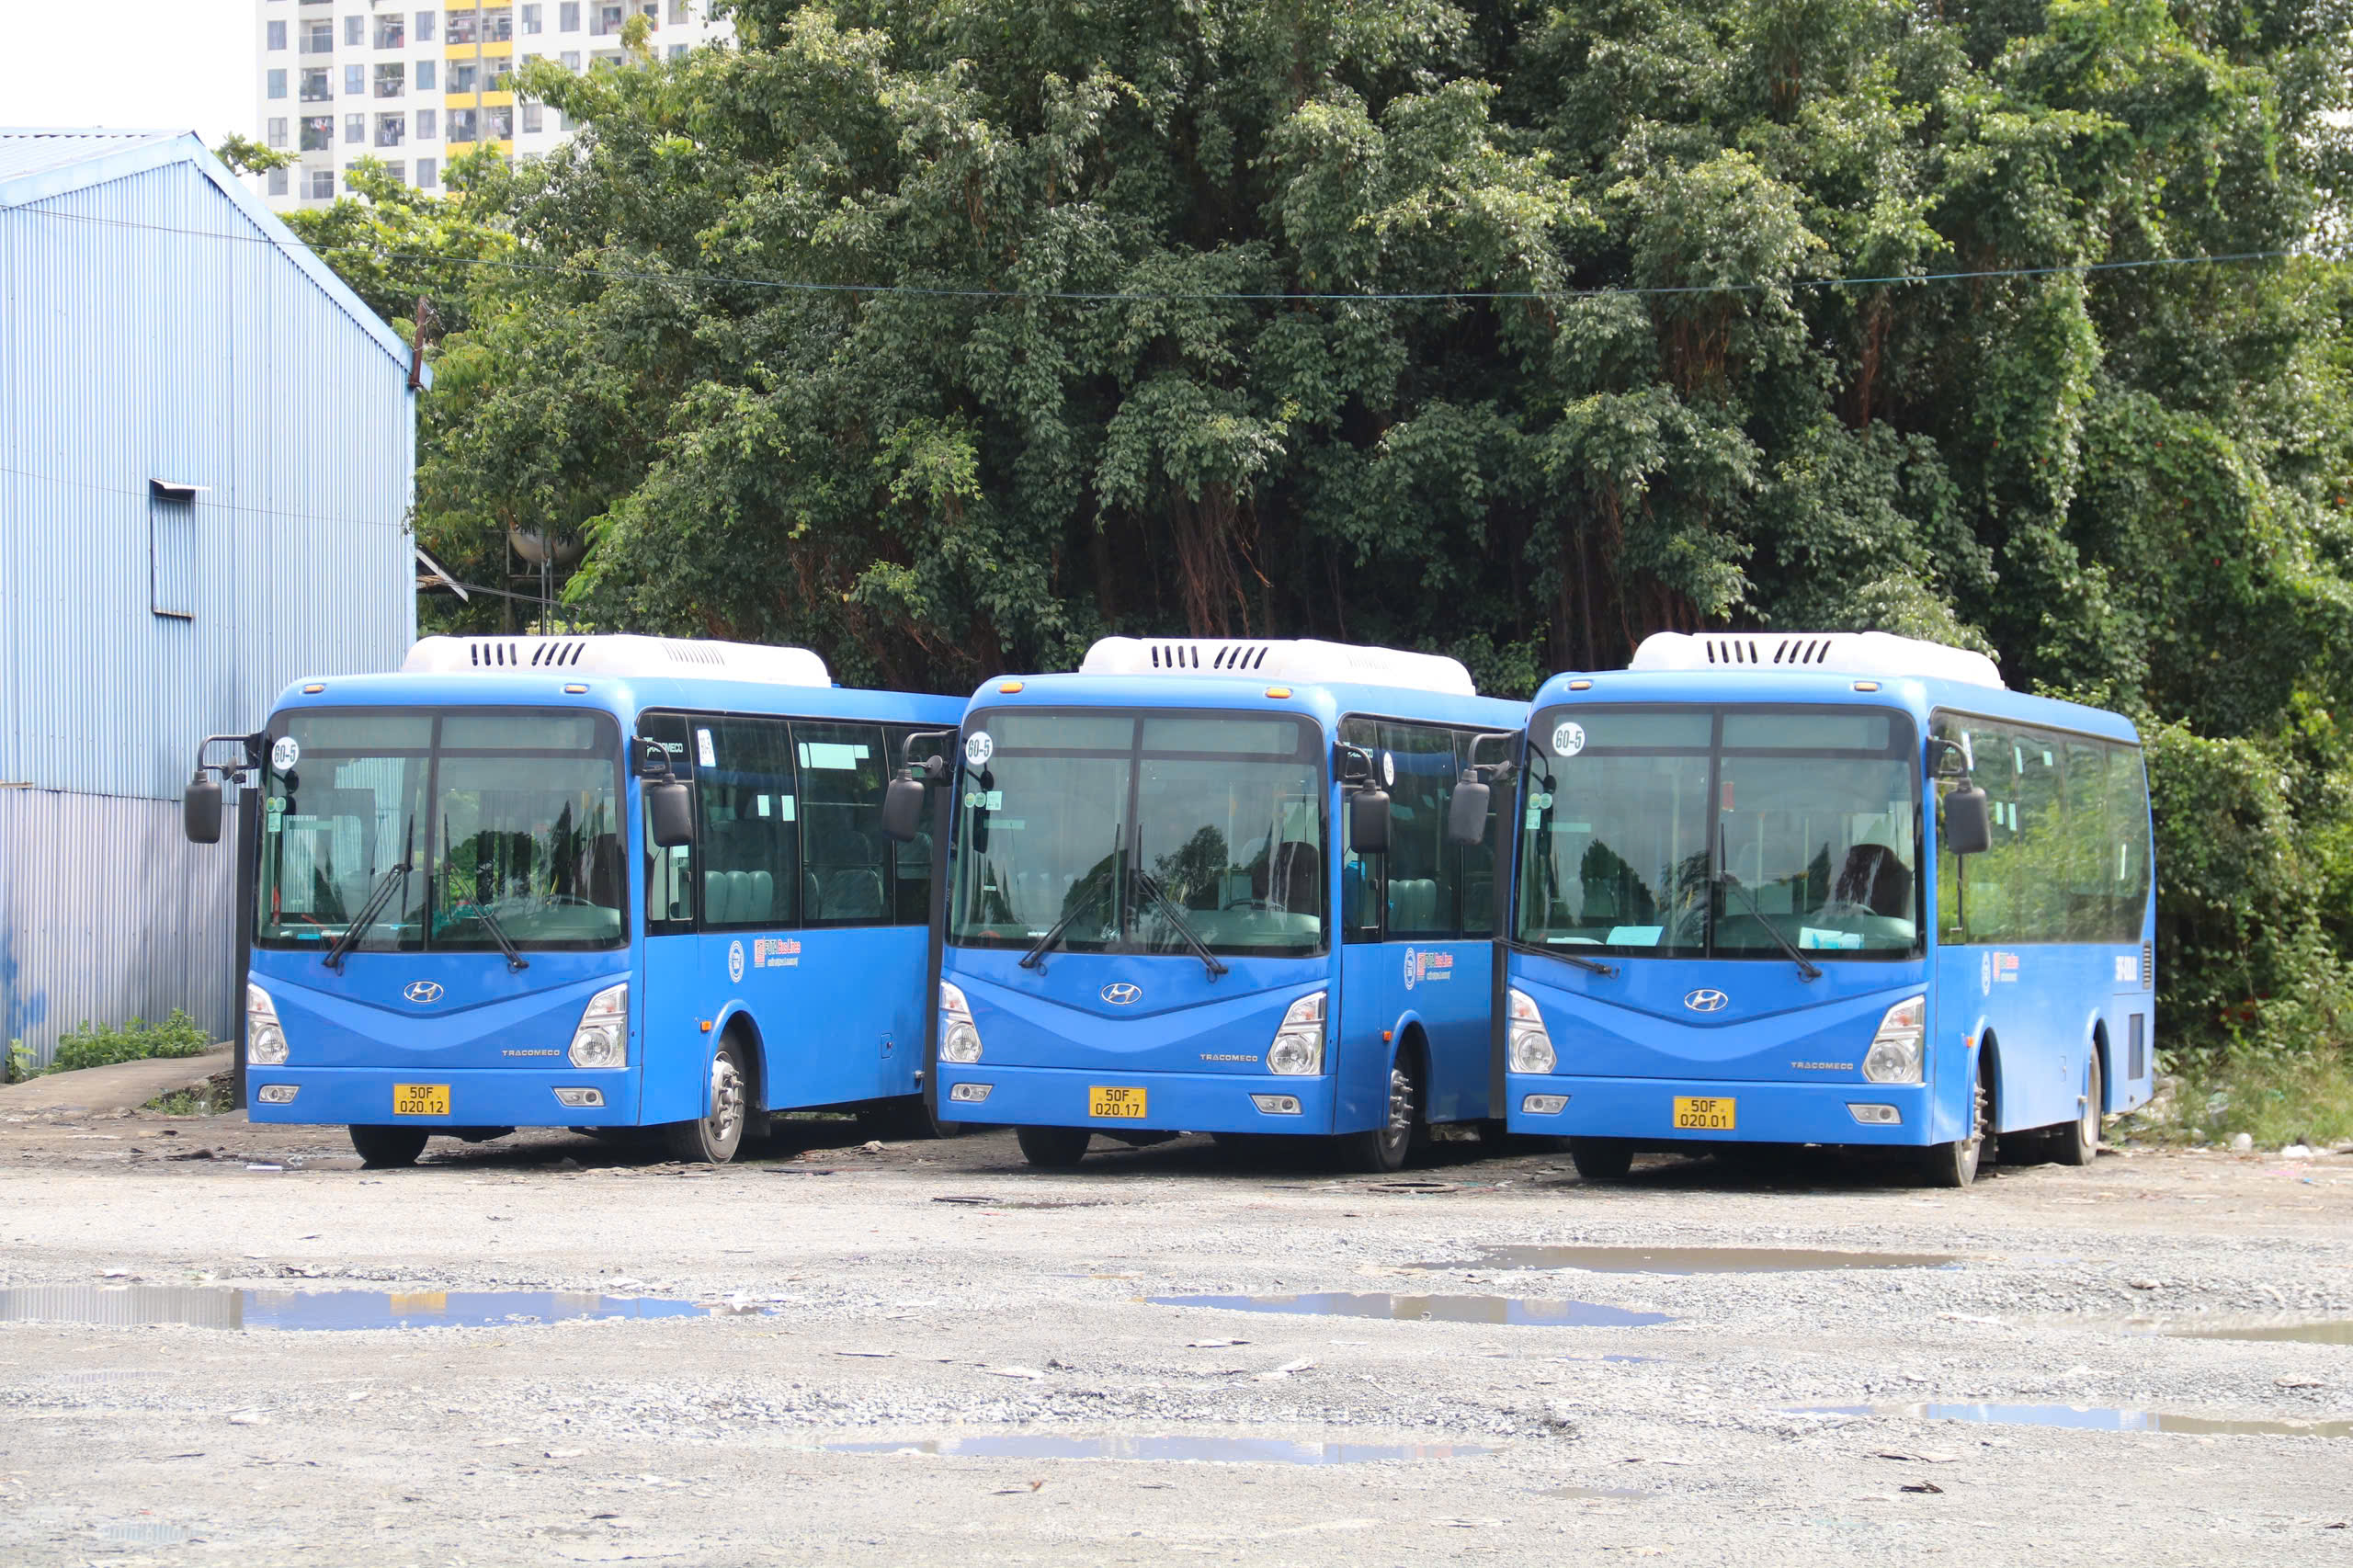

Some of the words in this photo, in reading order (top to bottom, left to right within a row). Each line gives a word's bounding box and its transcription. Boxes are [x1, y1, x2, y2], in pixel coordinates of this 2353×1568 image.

[1555, 730, 1582, 749] 60-5
[274, 744, 296, 763] 60-5
[968, 739, 990, 757] 60-5
[501, 1050, 560, 1058] TRACOMECO
[1199, 1053, 1258, 1062] TRACOMECO
[1790, 1061, 1854, 1071] TRACOMECO
[410, 1086, 434, 1099] 50F
[1106, 1089, 1130, 1102] 50F
[400, 1100, 443, 1113] 020.12
[1096, 1103, 1140, 1116] 020.17
[1691, 1099, 1717, 1113] 50F
[1680, 1113, 1727, 1128] 020.01
